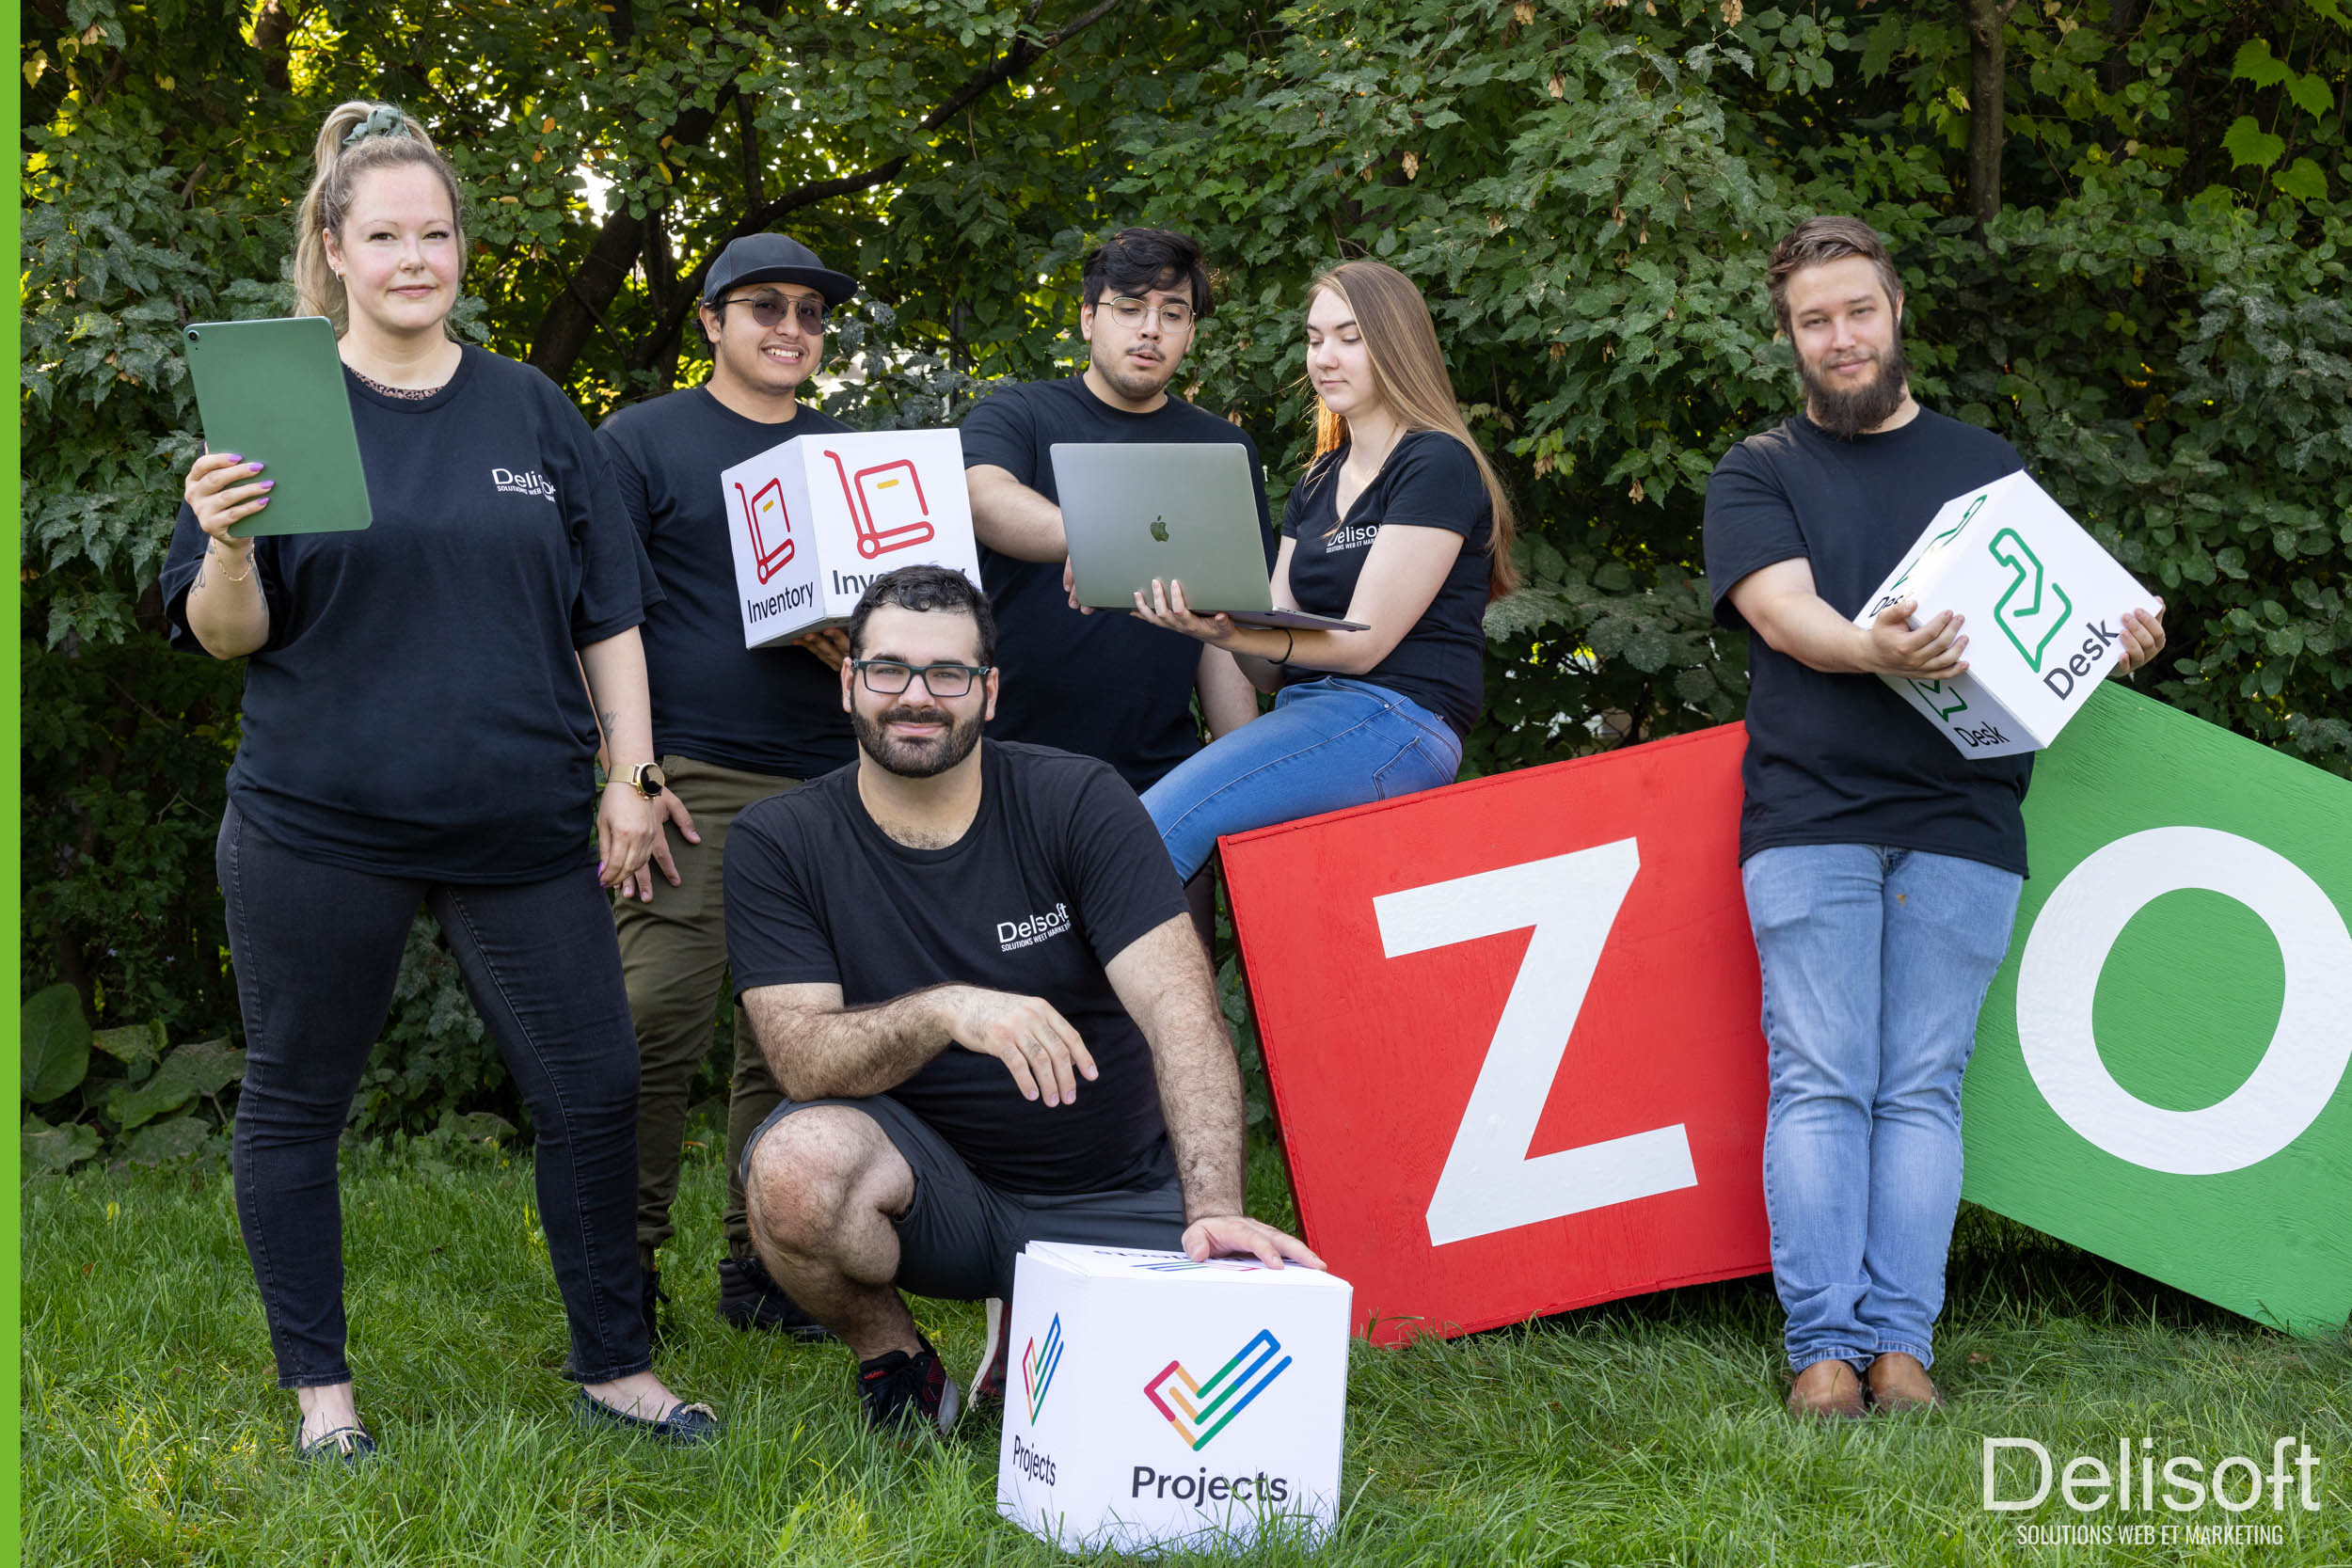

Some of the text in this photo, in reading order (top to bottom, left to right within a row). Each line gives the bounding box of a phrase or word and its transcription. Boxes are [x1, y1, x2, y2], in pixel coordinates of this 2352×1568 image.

[747, 581, 814, 624] Inventory
[2042, 619, 2120, 701] Desk
[1953, 721, 2010, 748] Desk
[1001, 938, 1034, 952] SOLUTIONS
[2016, 825, 2352, 1175] O
[1373, 837, 1698, 1246] Z
[1013, 1434, 1057, 1486] Projects
[1132, 1465, 1288, 1508] Projects
